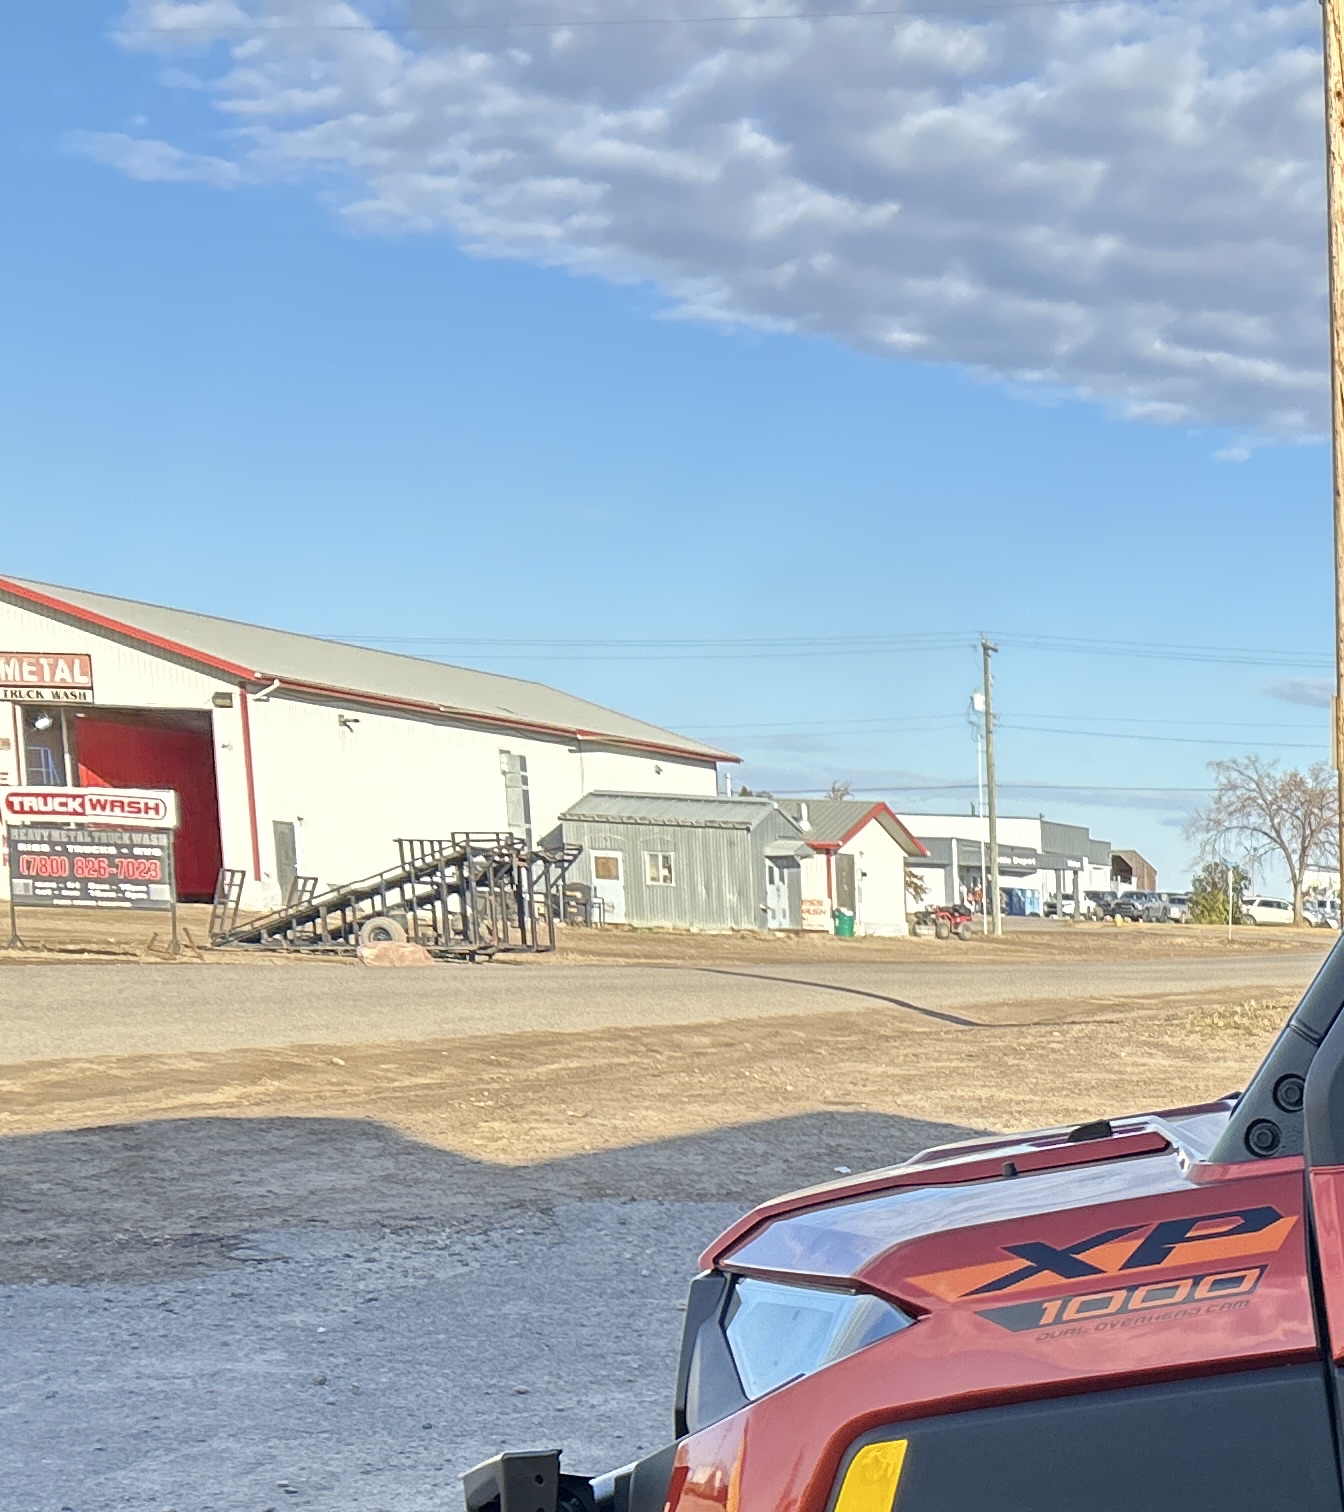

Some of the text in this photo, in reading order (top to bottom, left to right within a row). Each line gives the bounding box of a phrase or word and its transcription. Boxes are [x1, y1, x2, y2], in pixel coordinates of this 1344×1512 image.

[0, 657, 89, 684] METAL
[2, 688, 87, 701] TRUCK WASH
[8, 796, 160, 816] TRUCK WASH
[11, 828, 168, 846] HEAVY METAL TRUCK WASH
[19, 854, 161, 880] (780) 826-7023
[958, 1205, 1285, 1298] XP
[1039, 1268, 1263, 1326] 1000
[1036, 1300, 1250, 1342] DUAL OVERHEAD CAM
